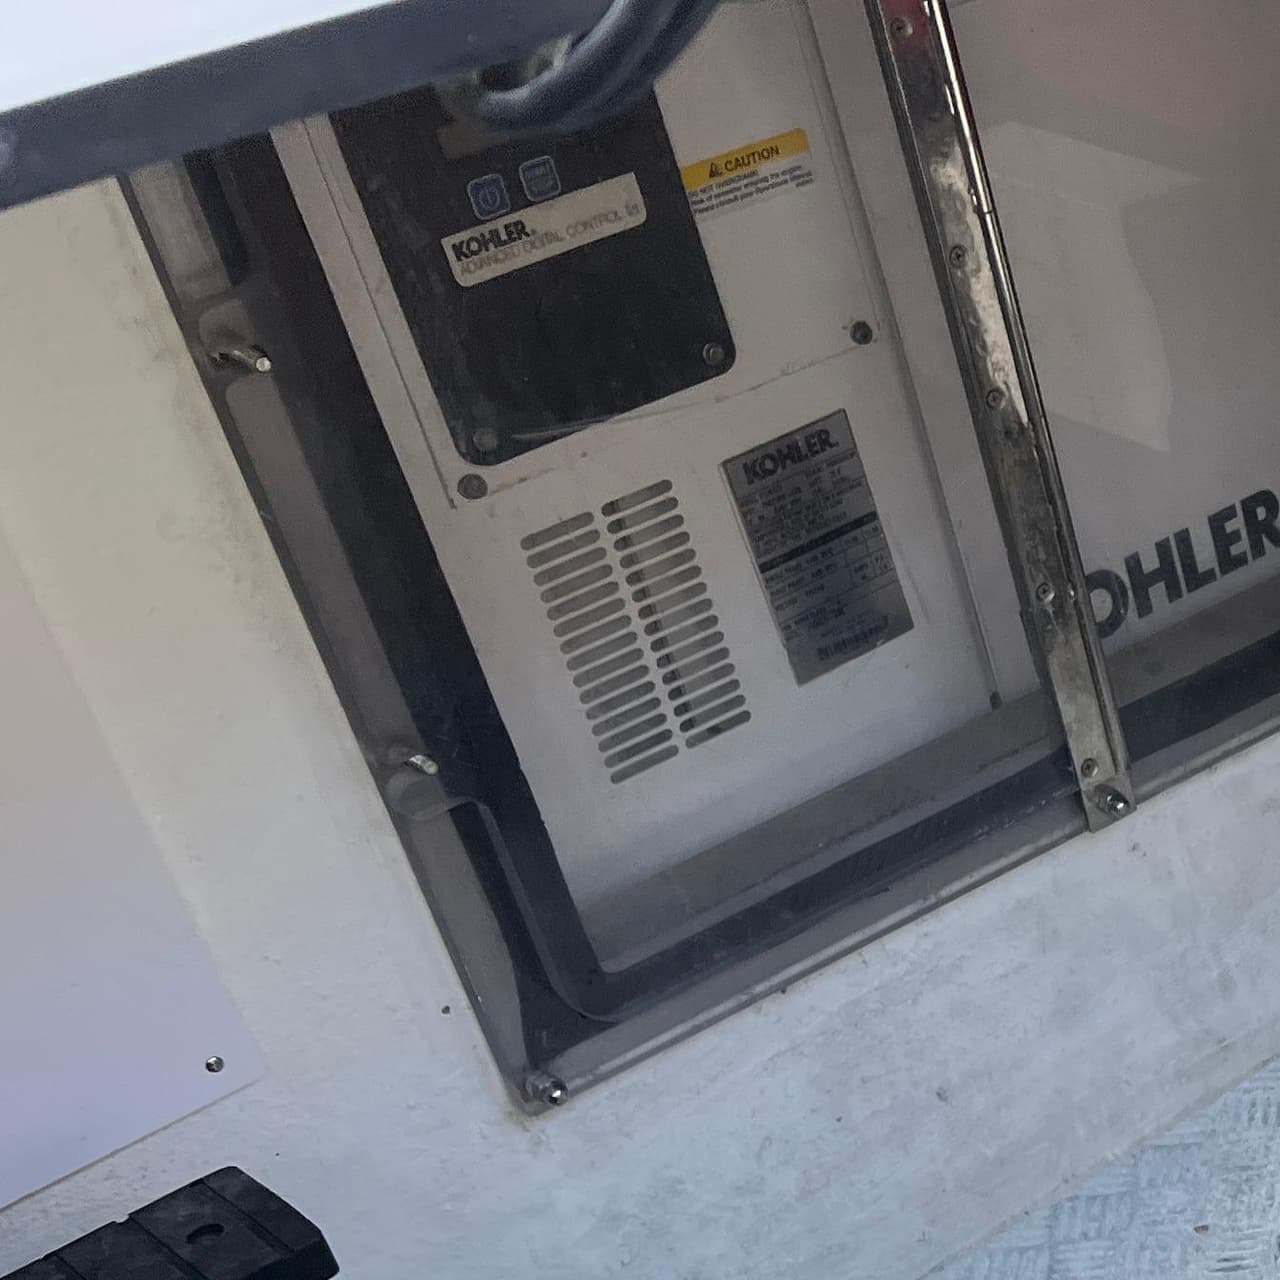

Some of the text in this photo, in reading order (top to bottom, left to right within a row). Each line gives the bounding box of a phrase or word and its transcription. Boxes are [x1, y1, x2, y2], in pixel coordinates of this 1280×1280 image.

[724, 144, 780, 172] CAUTION
[451, 219, 531, 262] KOHLER
[742, 428, 838, 485] KOHLER
